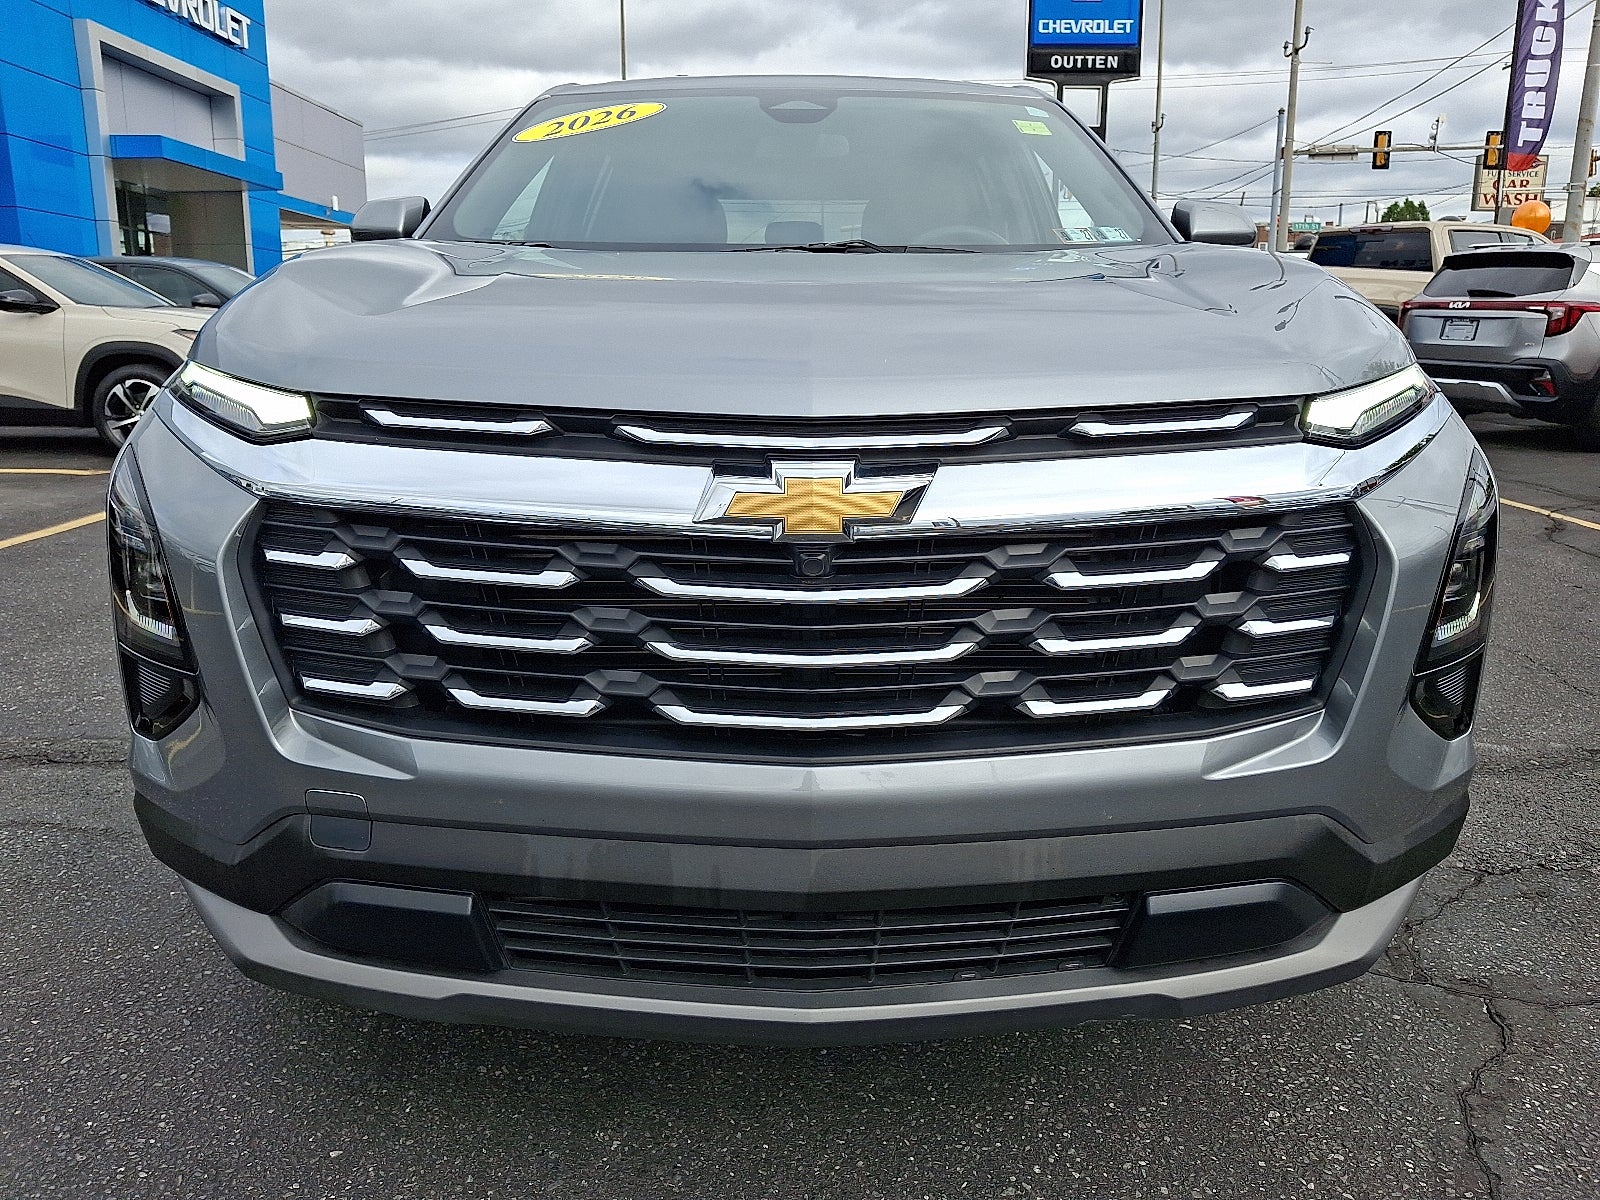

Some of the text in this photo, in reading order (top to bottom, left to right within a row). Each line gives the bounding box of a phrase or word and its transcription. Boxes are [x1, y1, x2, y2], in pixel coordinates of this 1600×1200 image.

[1038, 19, 1135, 34] CHEVROLET
[1050, 54, 1119, 69] OUTTEN
[1517, 0, 1559, 147] TRUCK
[541, 104, 638, 138] 2026
[1507, 170, 1540, 178] SERVICE
